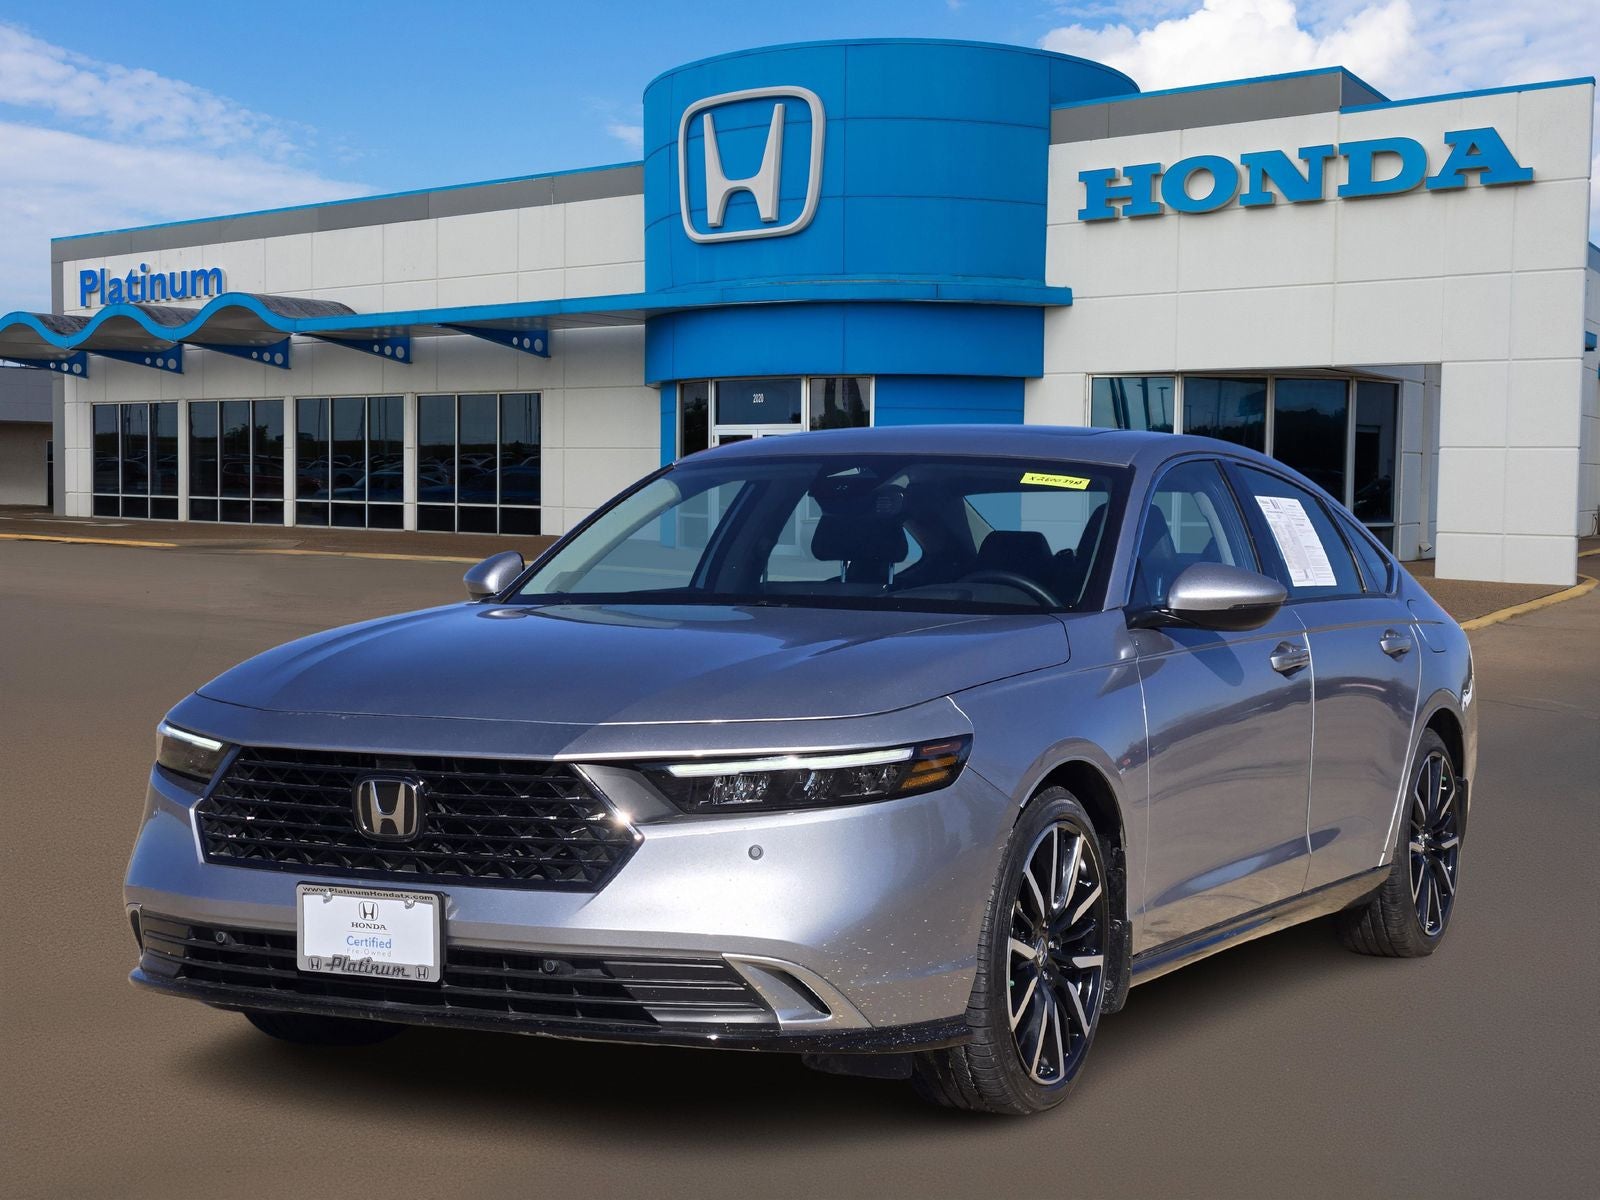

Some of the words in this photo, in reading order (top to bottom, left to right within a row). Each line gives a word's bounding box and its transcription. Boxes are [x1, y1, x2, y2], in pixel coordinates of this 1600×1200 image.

[1078, 126, 1534, 221] HONDA
[80, 263, 224, 306] Platinum
[351, 921, 388, 931] HONDA
[346, 935, 392, 949] Certified
[325, 954, 410, 978] Platinum
